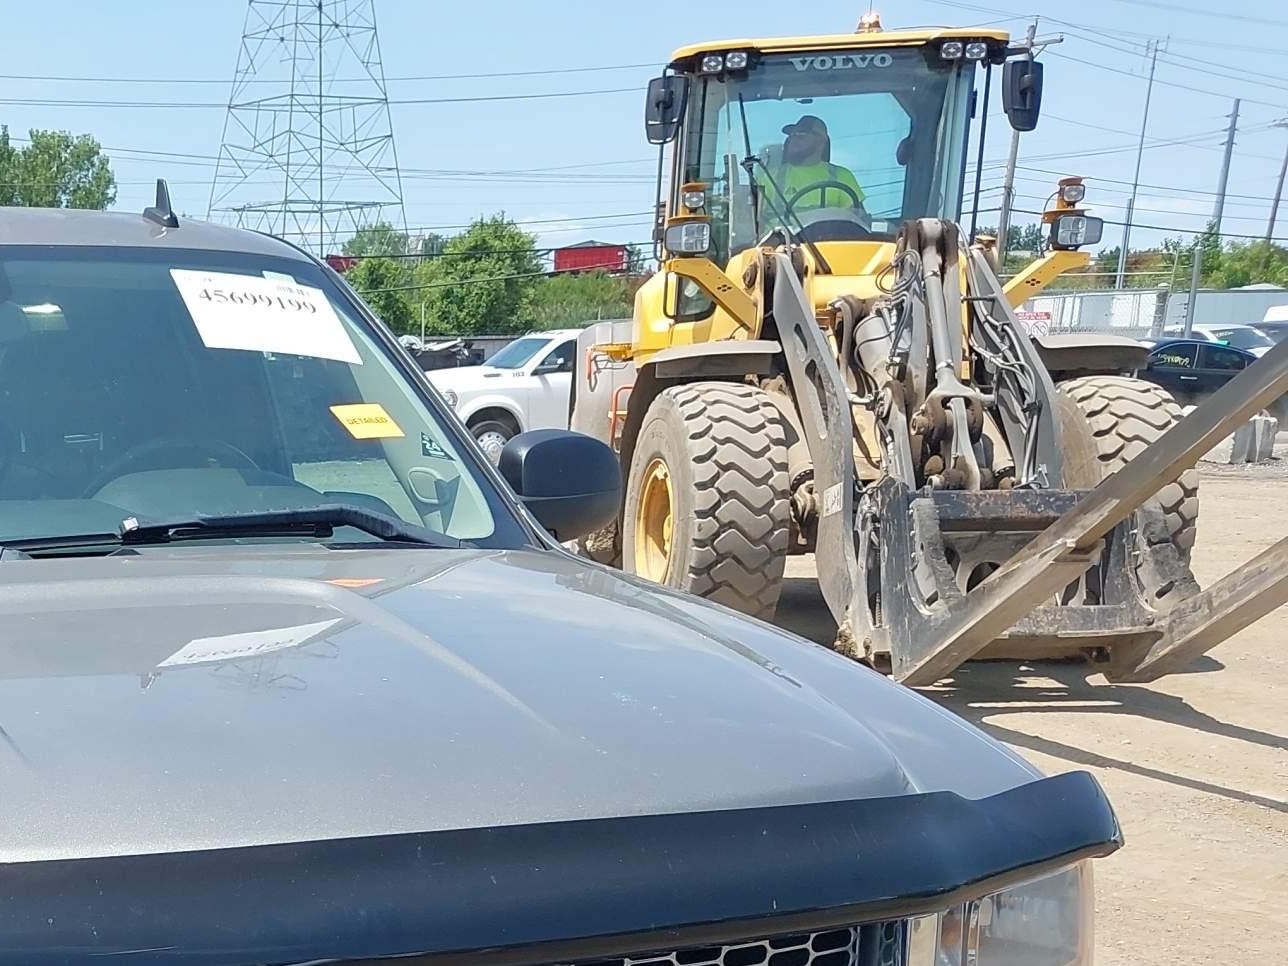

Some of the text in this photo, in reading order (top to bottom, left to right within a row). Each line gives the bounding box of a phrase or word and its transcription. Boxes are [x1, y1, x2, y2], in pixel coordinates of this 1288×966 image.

[789, 53, 893, 71] VOLVO
[199, 288, 318, 314] 45699199
[345, 416, 388, 425] DETAILED
